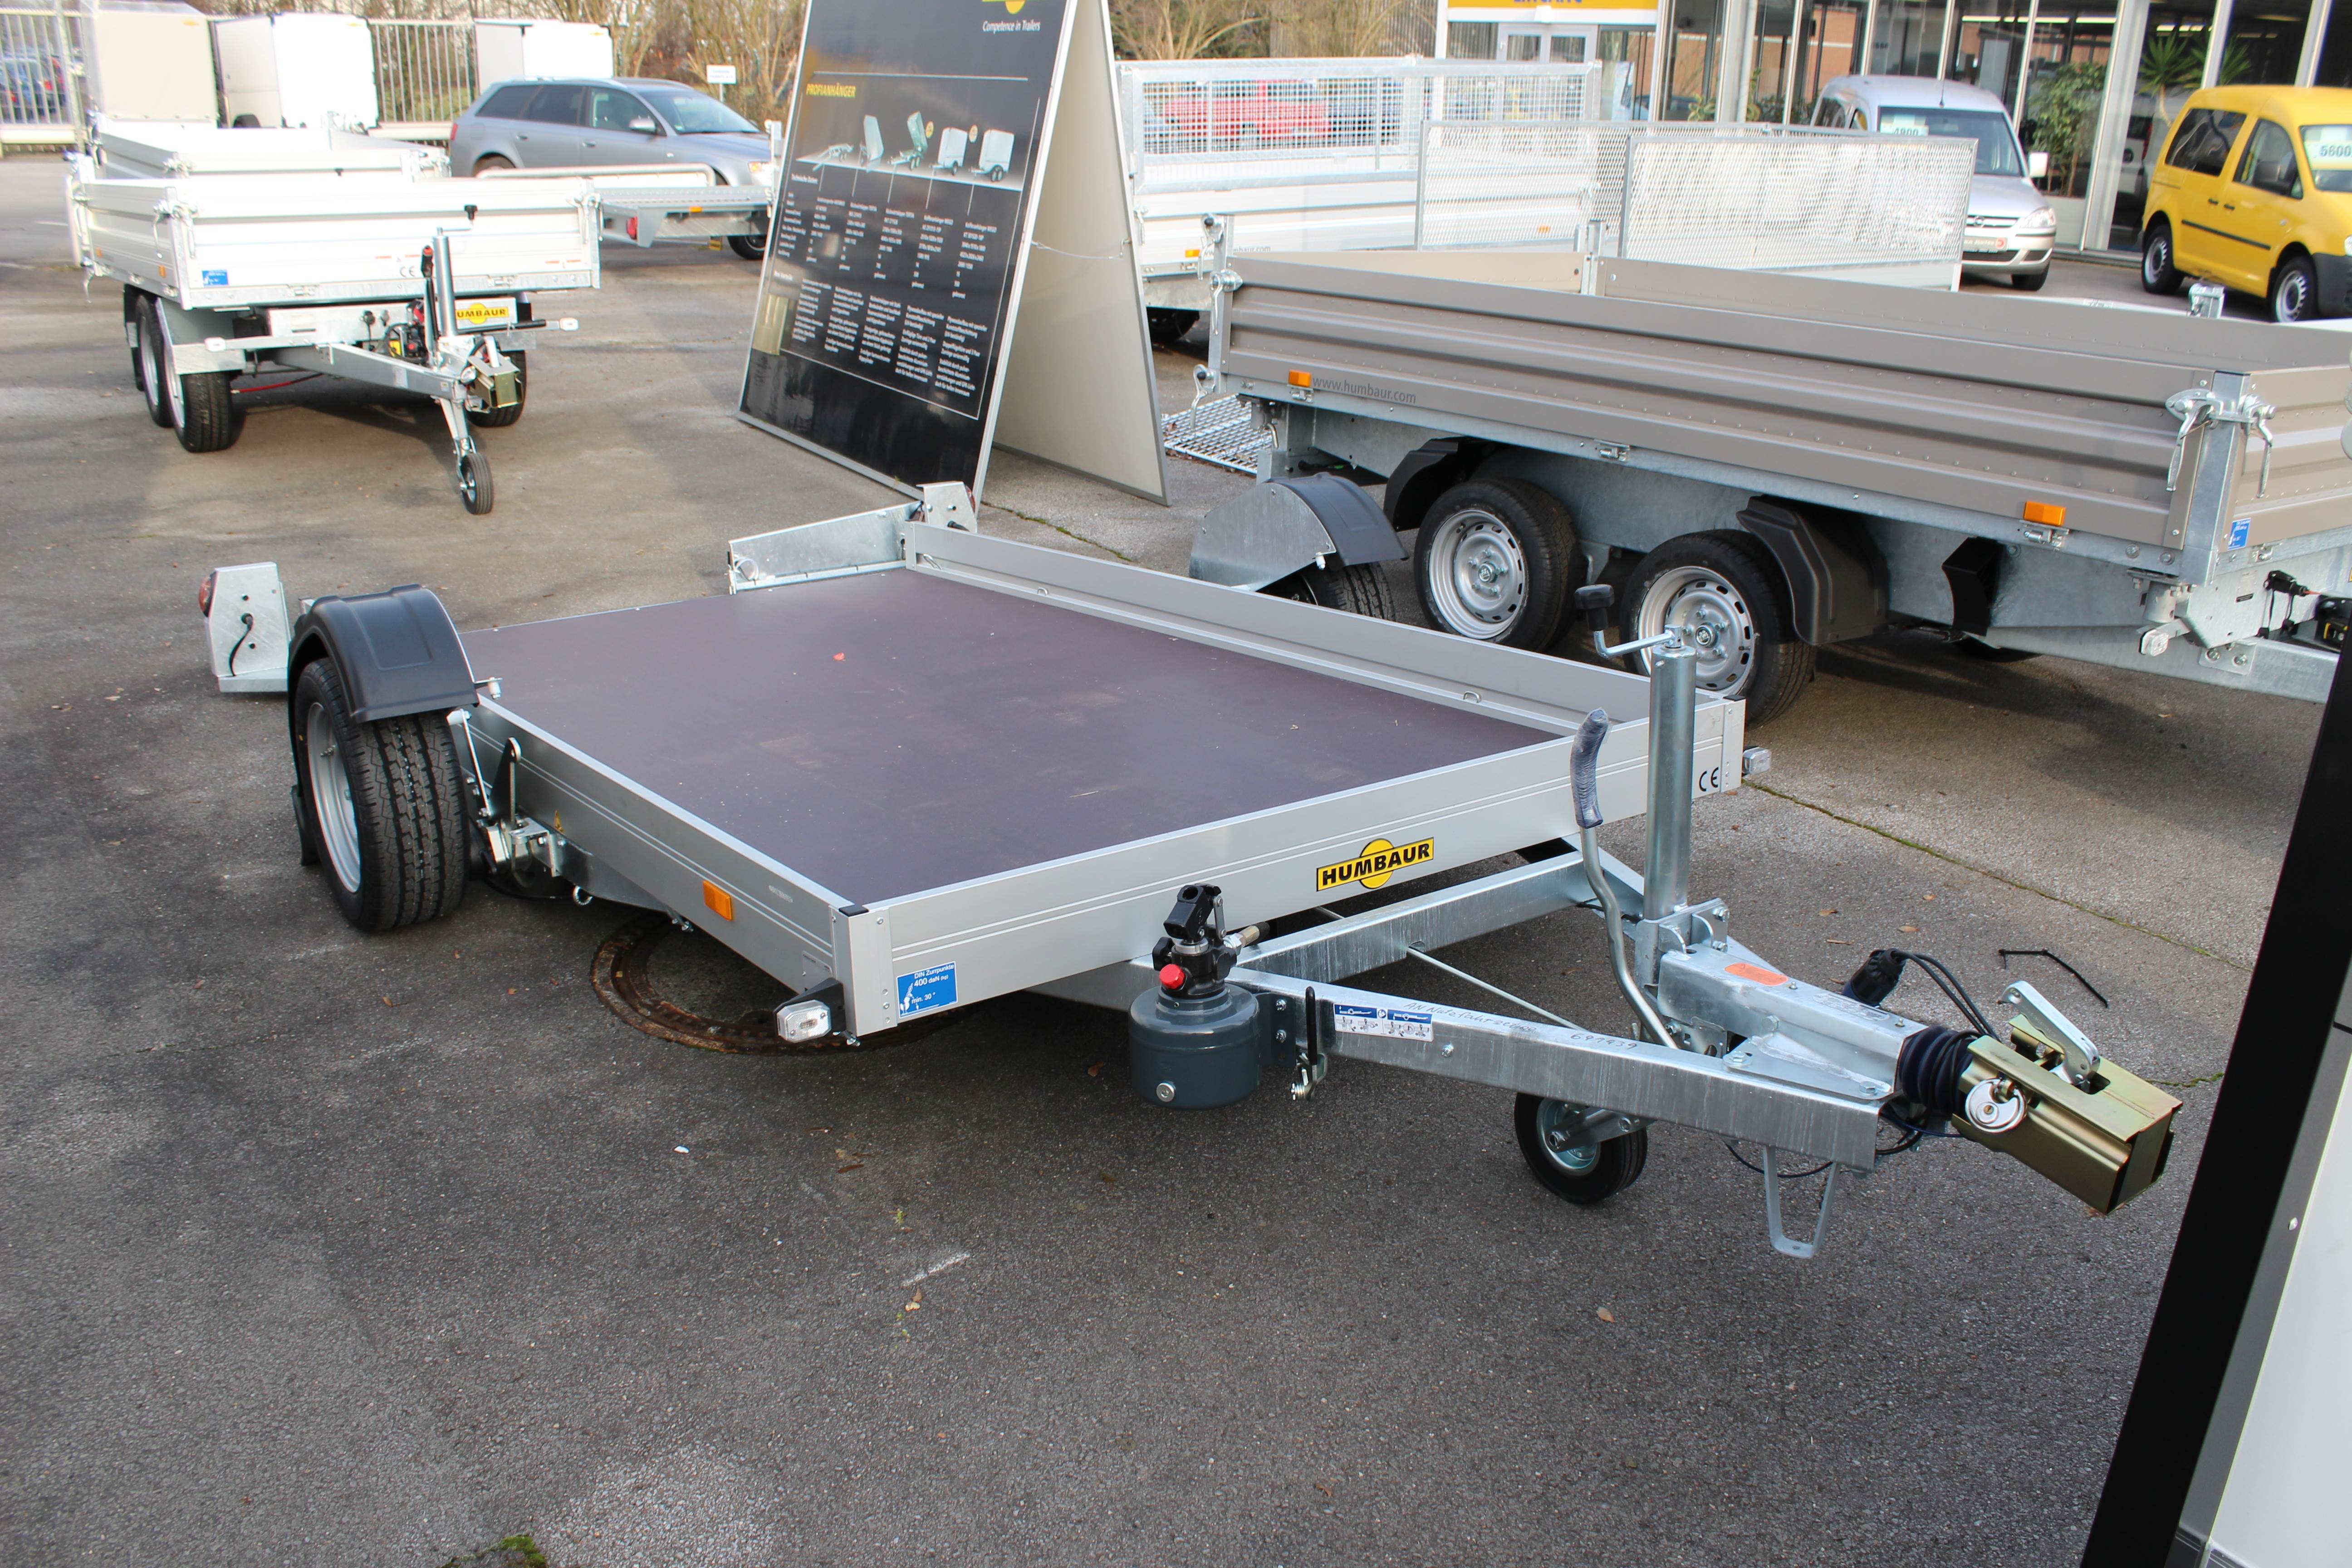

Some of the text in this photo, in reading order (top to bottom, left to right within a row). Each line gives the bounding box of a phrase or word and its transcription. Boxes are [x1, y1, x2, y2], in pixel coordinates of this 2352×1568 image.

[982, 20, 1015, 35] Competence
[1022, 19, 1041, 31] Trailers
[456, 309, 506, 318] UMBAUR
[1313, 377, 1416, 403] www.humbaur.com
[1699, 767, 1719, 792] CE
[1323, 843, 1430, 886] HUMBAUR
[926, 964, 954, 975] Zurrpunkte
[914, 978, 927, 987] 400
